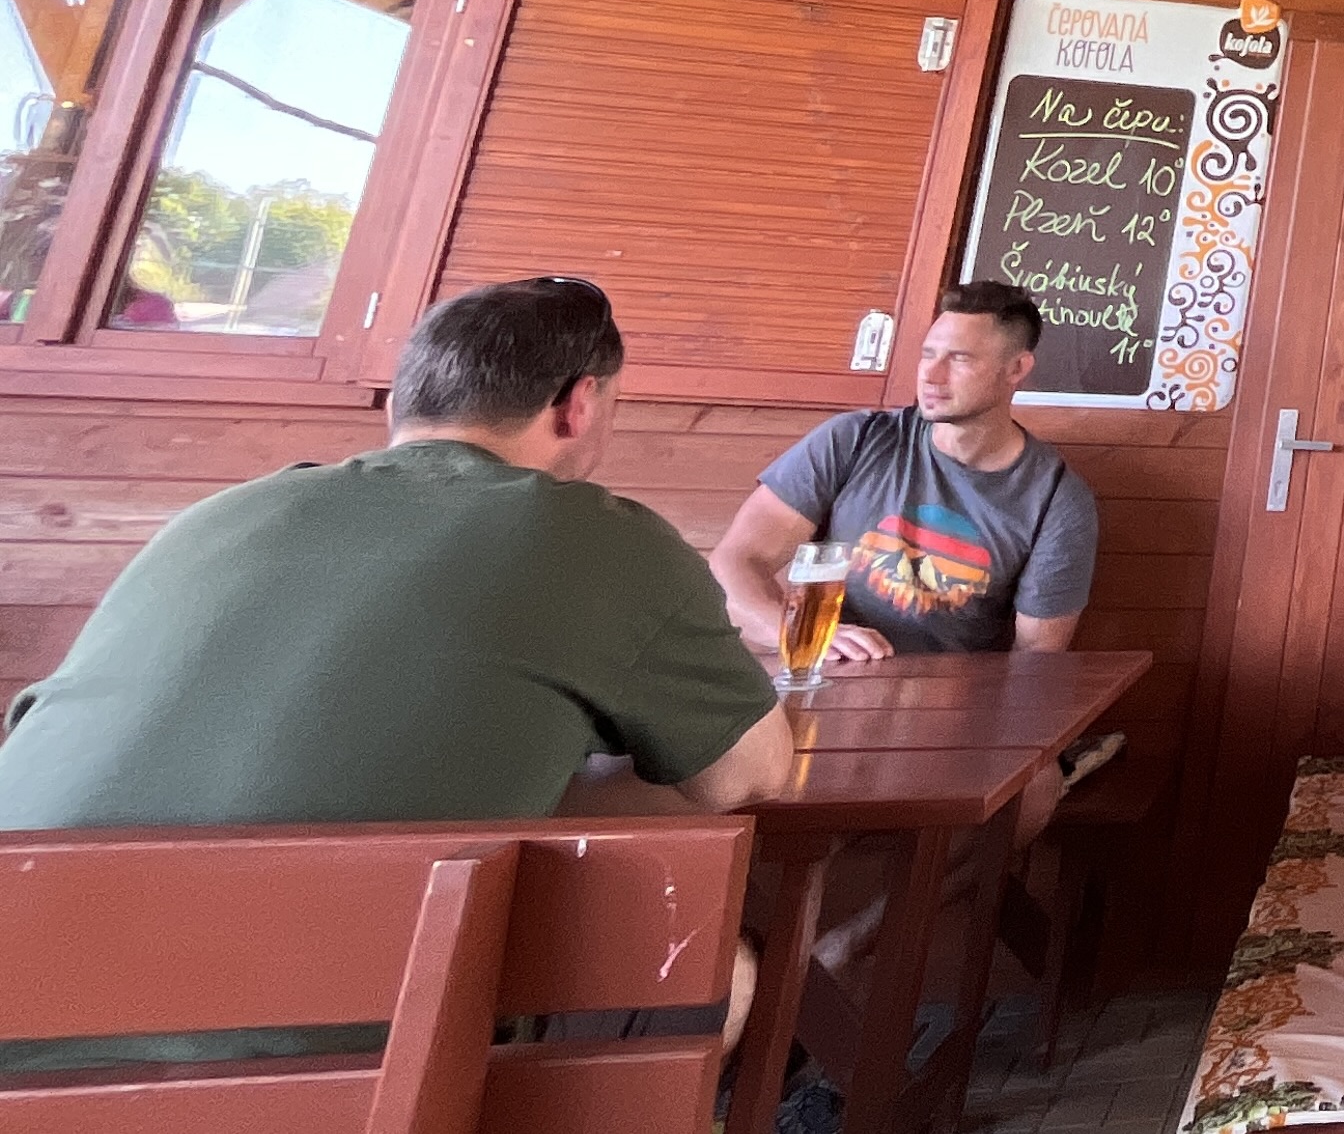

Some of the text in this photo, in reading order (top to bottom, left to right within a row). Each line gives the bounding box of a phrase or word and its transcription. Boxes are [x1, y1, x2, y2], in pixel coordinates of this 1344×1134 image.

[1224, 31, 1273, 57] kofola
[1030, 87, 1093, 126] Na
[1019, 138, 1127, 189] Kozel
[1003, 189, 1111, 242] Plzeň
